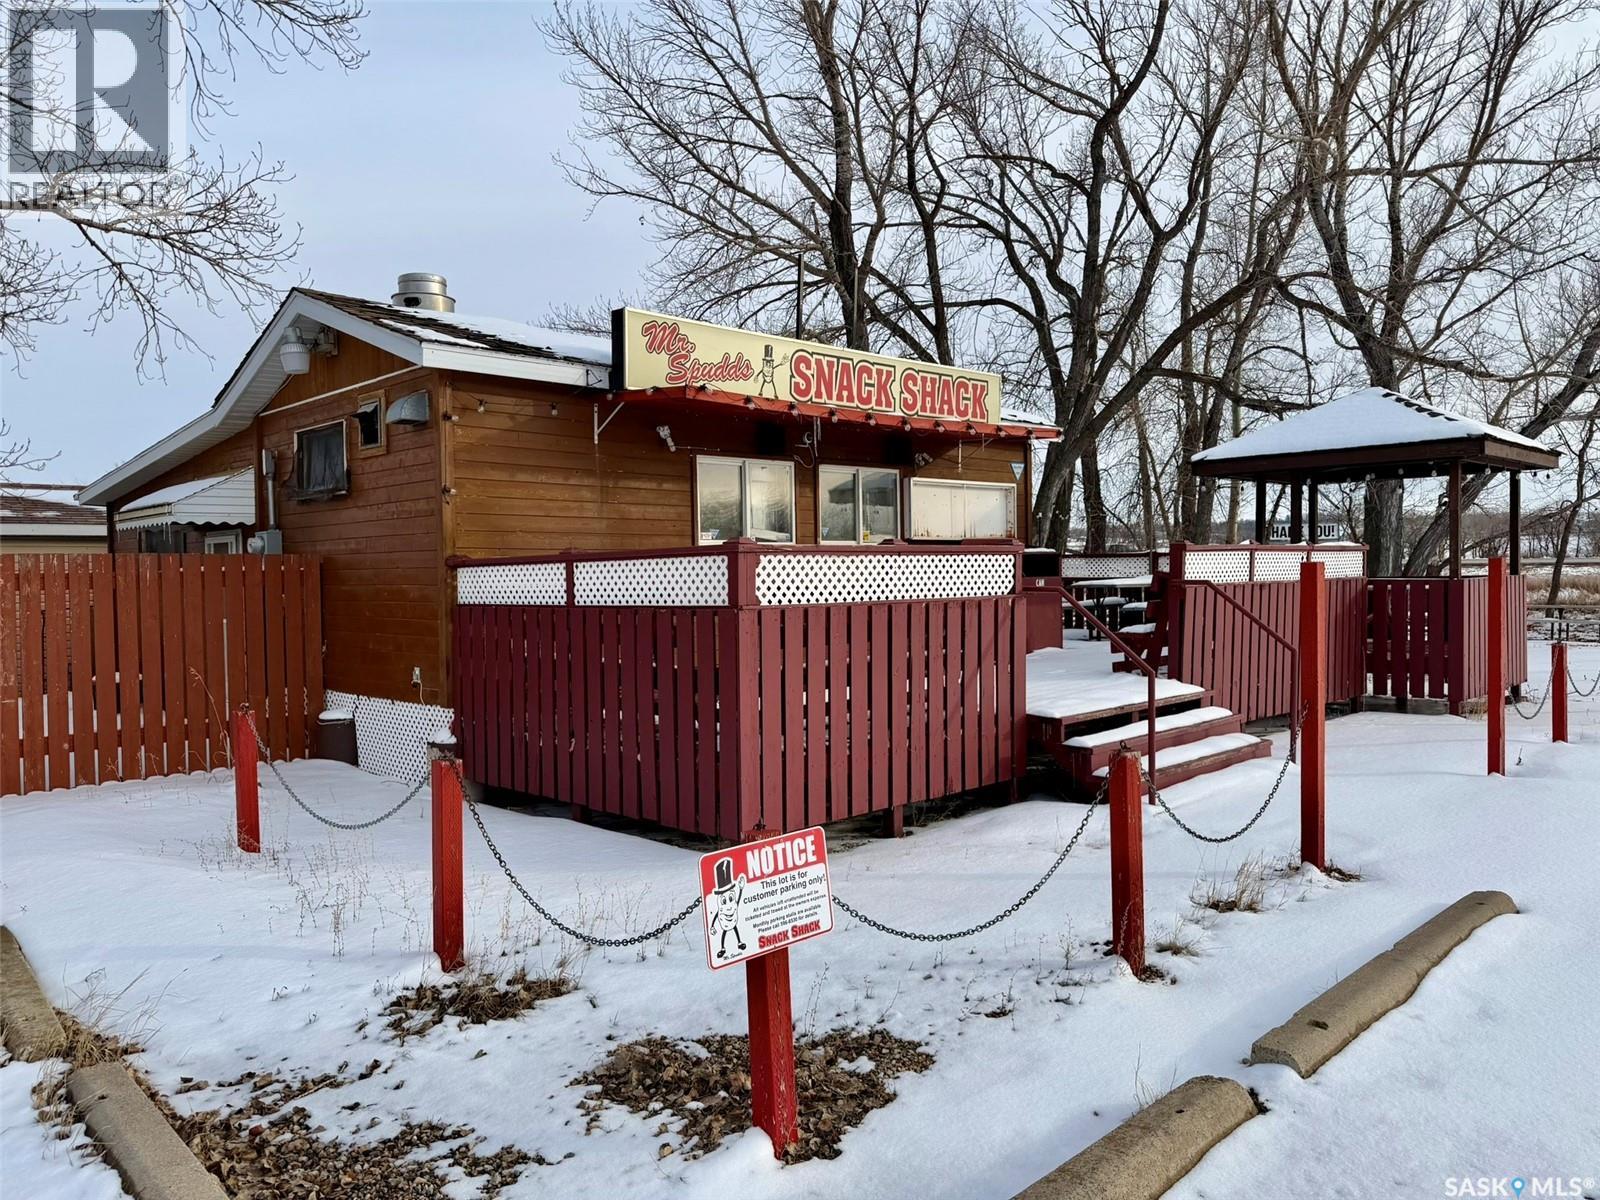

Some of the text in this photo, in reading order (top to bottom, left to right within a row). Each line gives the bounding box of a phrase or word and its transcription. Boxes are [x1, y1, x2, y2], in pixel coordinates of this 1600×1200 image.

[641, 320, 696, 355] Mr.
[666, 351, 754, 385] Spudds
[790, 349, 989, 423] SNACK SHACK
[746, 835, 817, 879] NOTICE
[743, 874, 826, 905] customer parking only!
[761, 869, 808, 890] This lot is for
[784, 893, 806, 903] unattended
[753, 919, 769, 930] Monthly
[770, 915, 785, 925] parking
[758, 925, 772, 934] Please
[758, 919, 821, 949] SNACK SHACK
